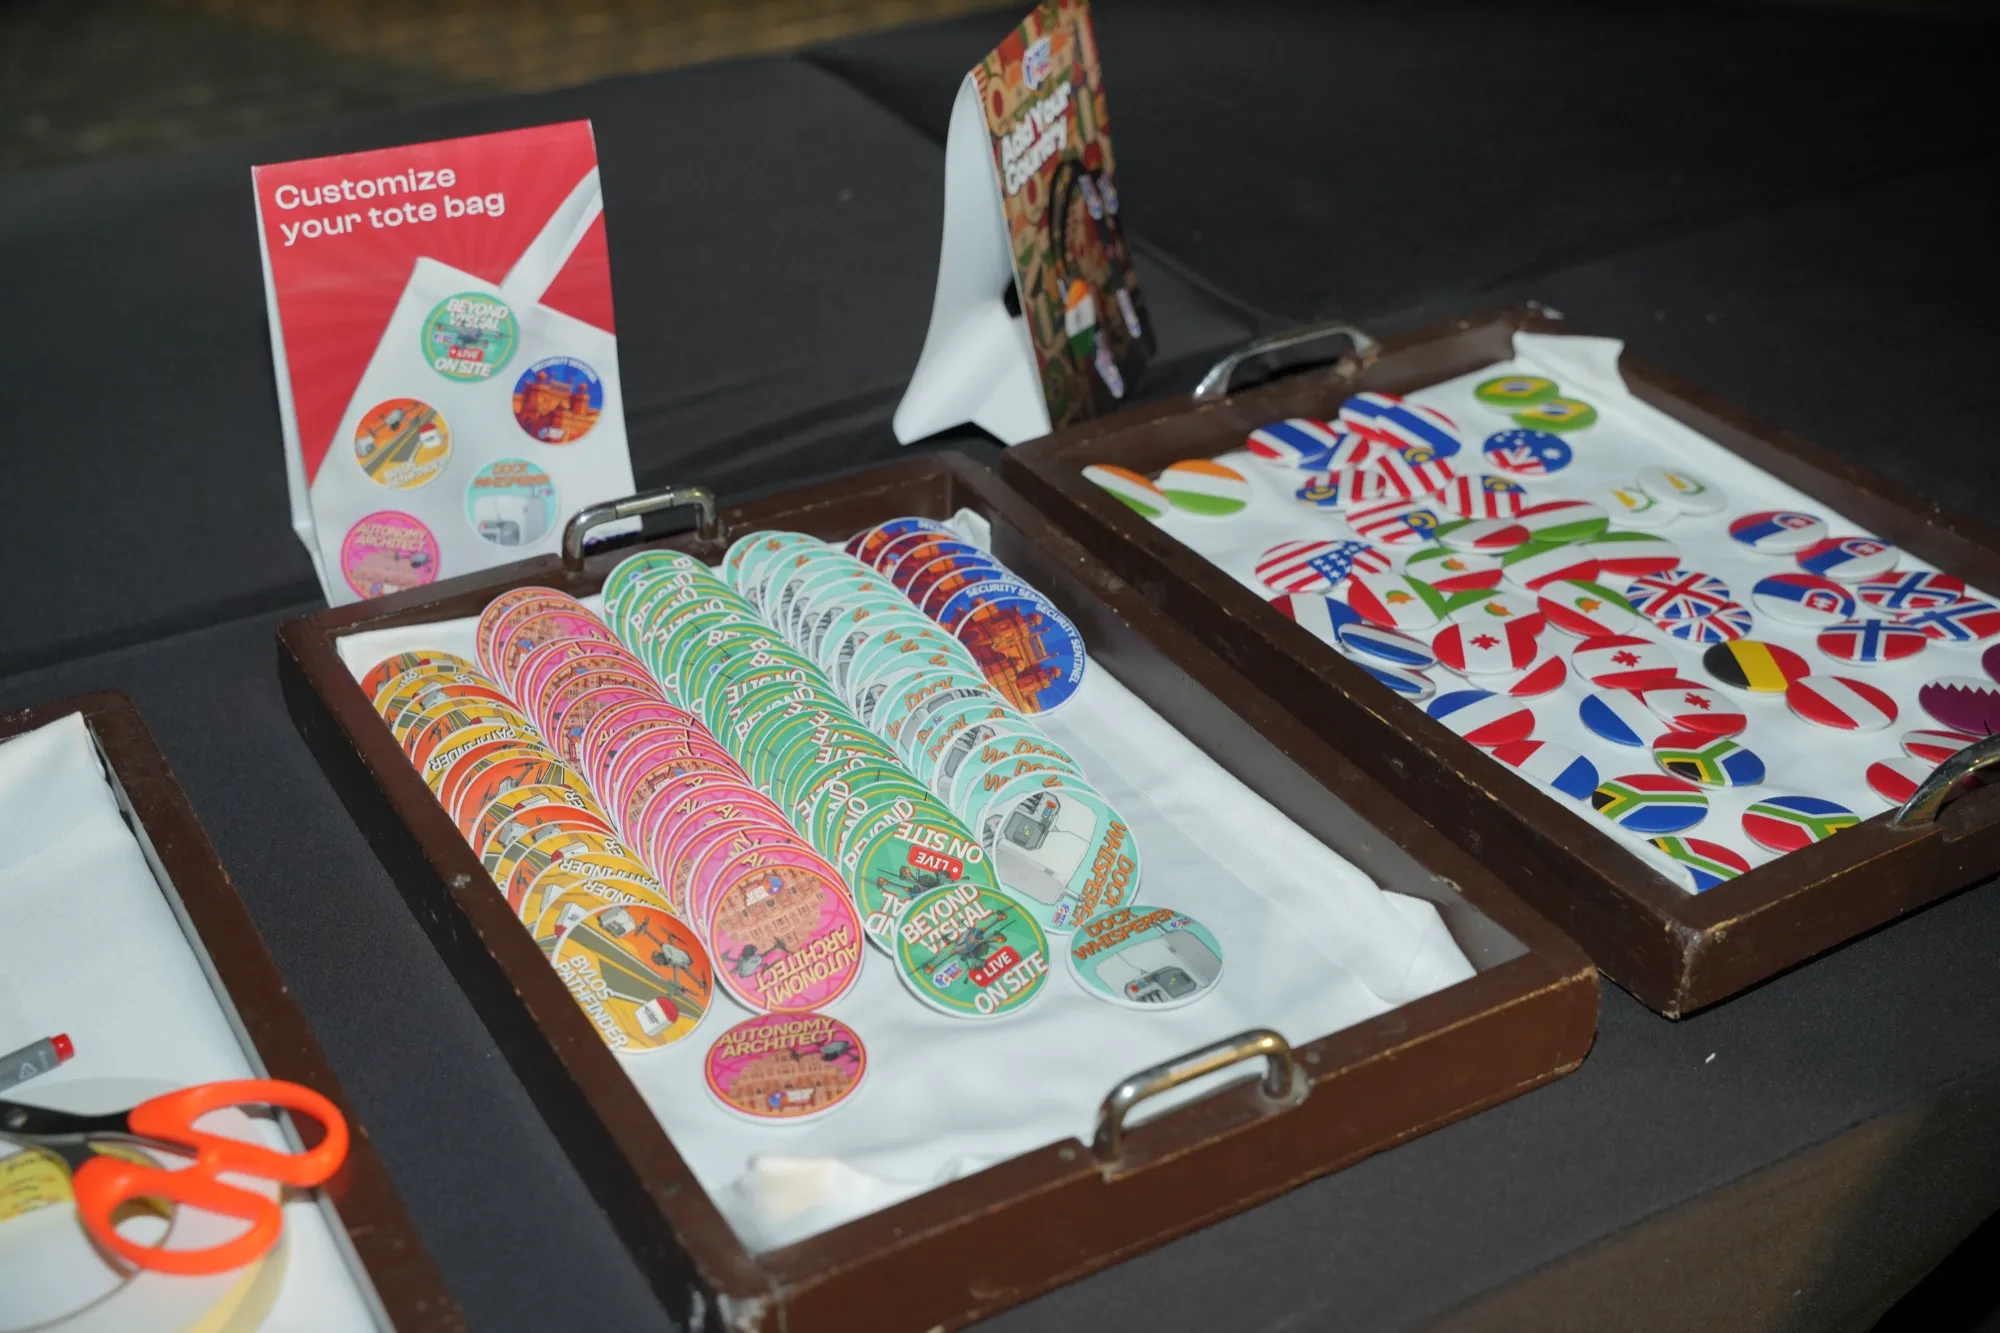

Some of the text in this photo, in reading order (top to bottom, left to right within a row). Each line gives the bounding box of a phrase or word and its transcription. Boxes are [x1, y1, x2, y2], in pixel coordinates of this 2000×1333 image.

[274, 168, 456, 210] Customize
[280, 192, 505, 247] your tote bag
[448, 299, 509, 319] BEYOND
[966, 583, 1018, 598] SECURITY
[1035, 602, 1084, 684] SECURITY SENTINEL
[843, 800, 917, 873] BEOND
[894, 821, 984, 865] ON SITE
[915, 851, 950, 872] LIVE
[1070, 820, 1128, 928] WHISPERER
[1101, 853, 1136, 909] DOCK
[901, 884, 981, 945] BEYOND
[920, 901, 995, 954] VISUAL
[1071, 908, 1177, 961] WHISPERER
[1084, 907, 1138, 938] DOCK
[569, 954, 614, 1001] BVLOS
[755, 925, 849, 993] ARCHITECT
[765, 941, 859, 1010] AUTONOMY
[974, 981, 1010, 1014] ON
[1005, 951, 1049, 993] SITE
[983, 951, 1013, 978] LIVE
[556, 961, 629, 1050] PATHFINDER
[718, 1018, 837, 1047] AUTONOMY
[721, 1028, 838, 1059] ARCHITECT
